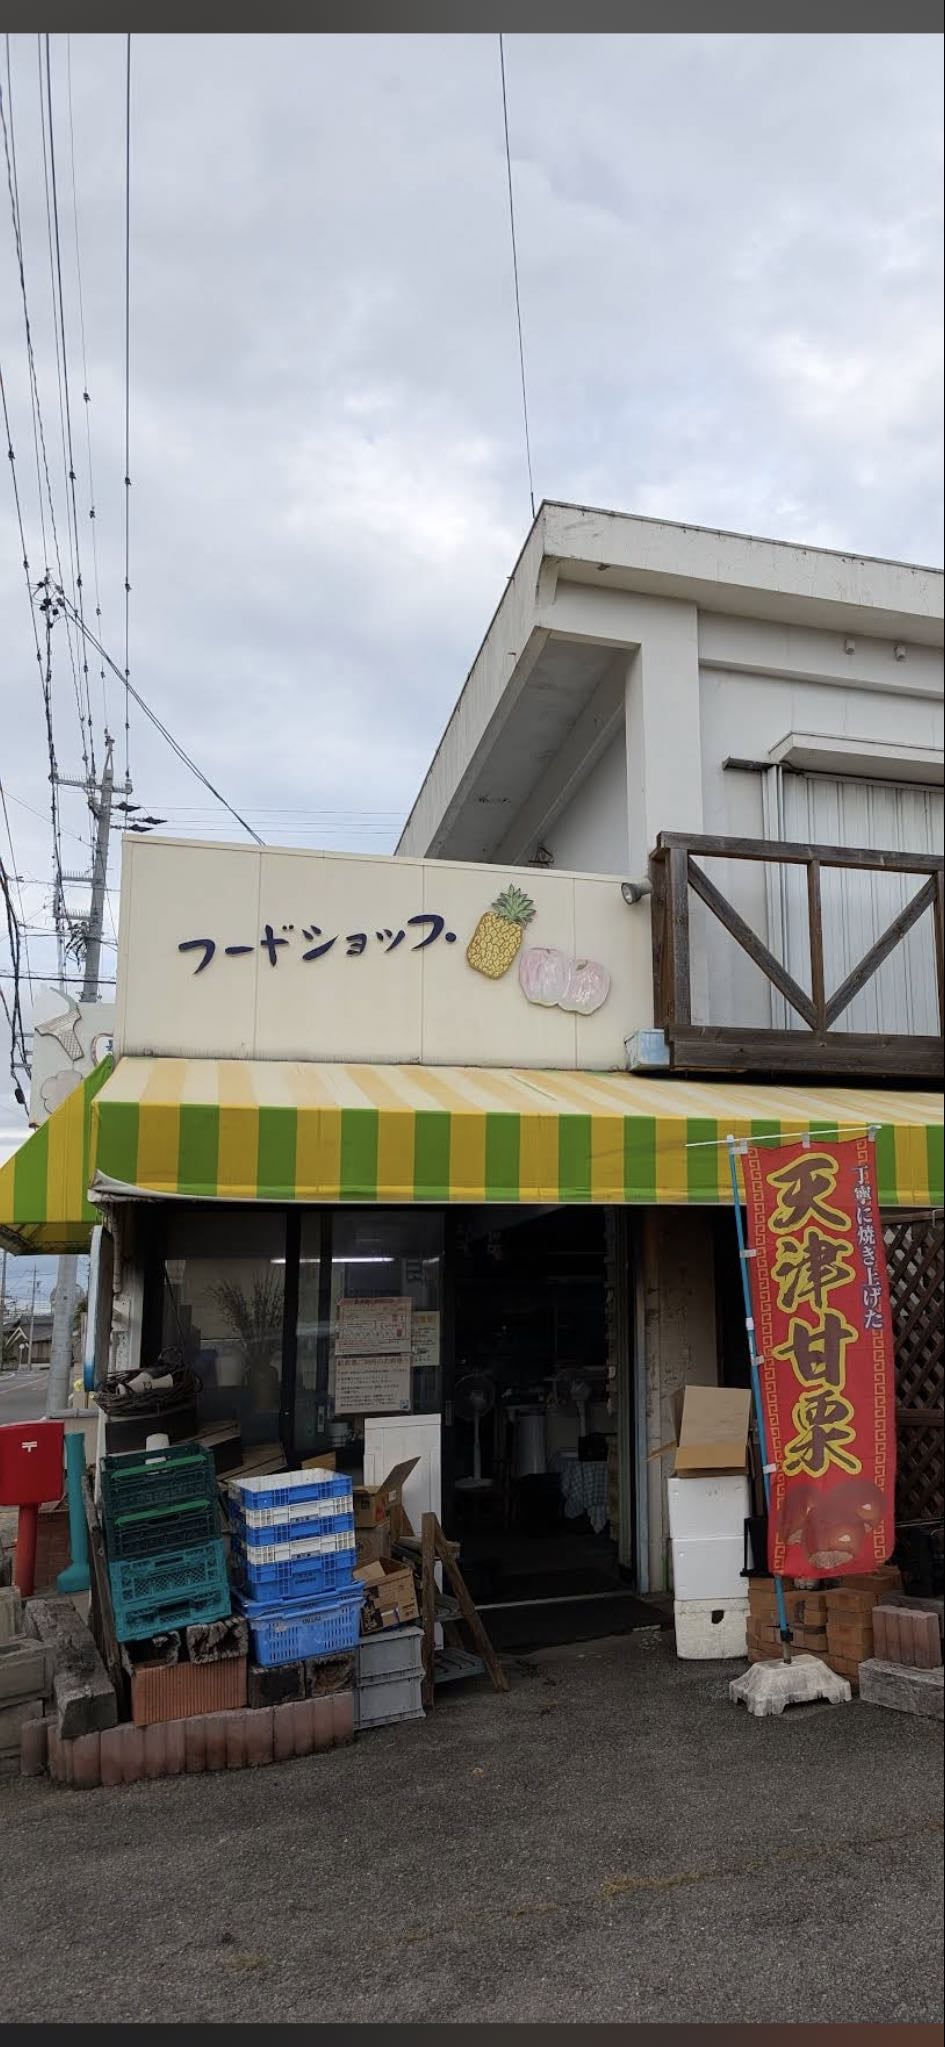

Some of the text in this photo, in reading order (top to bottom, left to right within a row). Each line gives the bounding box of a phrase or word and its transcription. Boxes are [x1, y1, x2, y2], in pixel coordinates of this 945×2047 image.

[178, 914, 457, 975] フードショップ
[767, 1152, 862, 1478] 天津甘栗
[850, 1165, 884, 1329] 丁寧に焼き上げた
